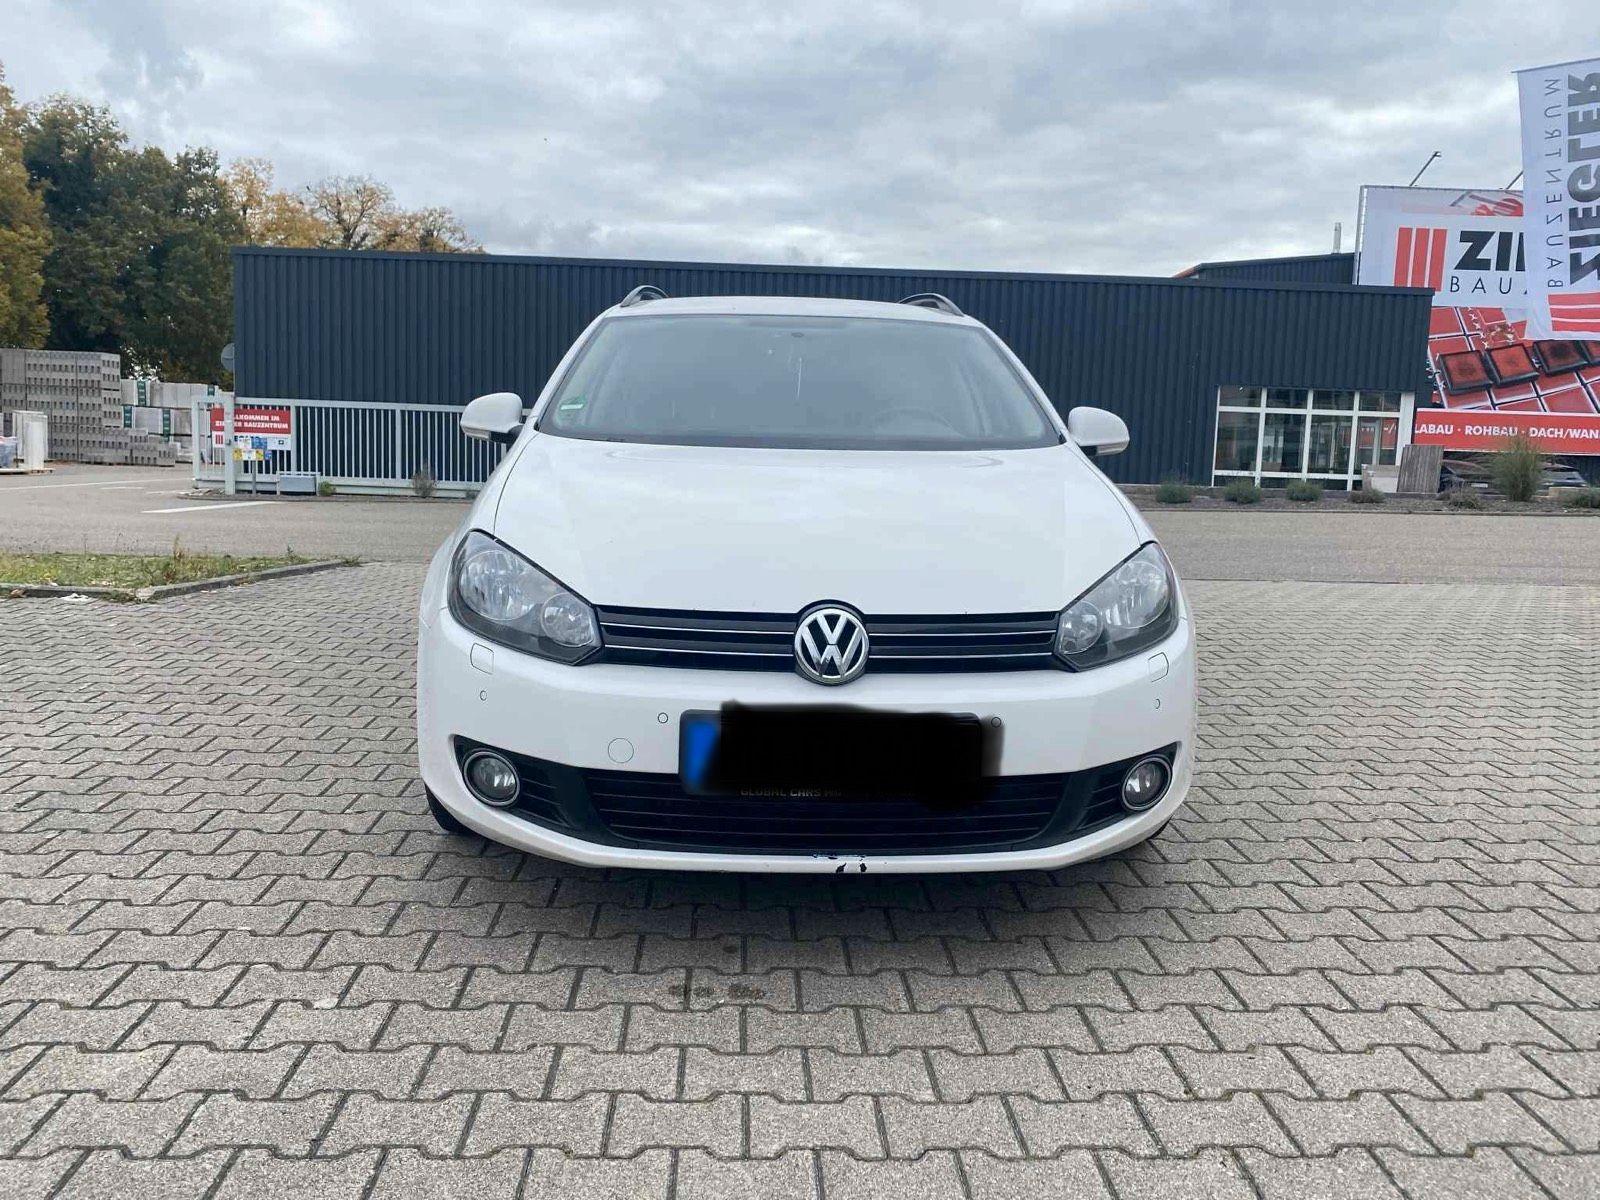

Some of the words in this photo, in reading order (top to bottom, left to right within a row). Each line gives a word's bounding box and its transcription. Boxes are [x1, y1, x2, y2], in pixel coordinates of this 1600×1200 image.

[1449, 275, 1528, 295] BAU
[1414, 423, 1454, 434] LABAU
[1465, 425, 1518, 436] ROHBAU
[1529, 427, 1600, 439] DACH/WAN
